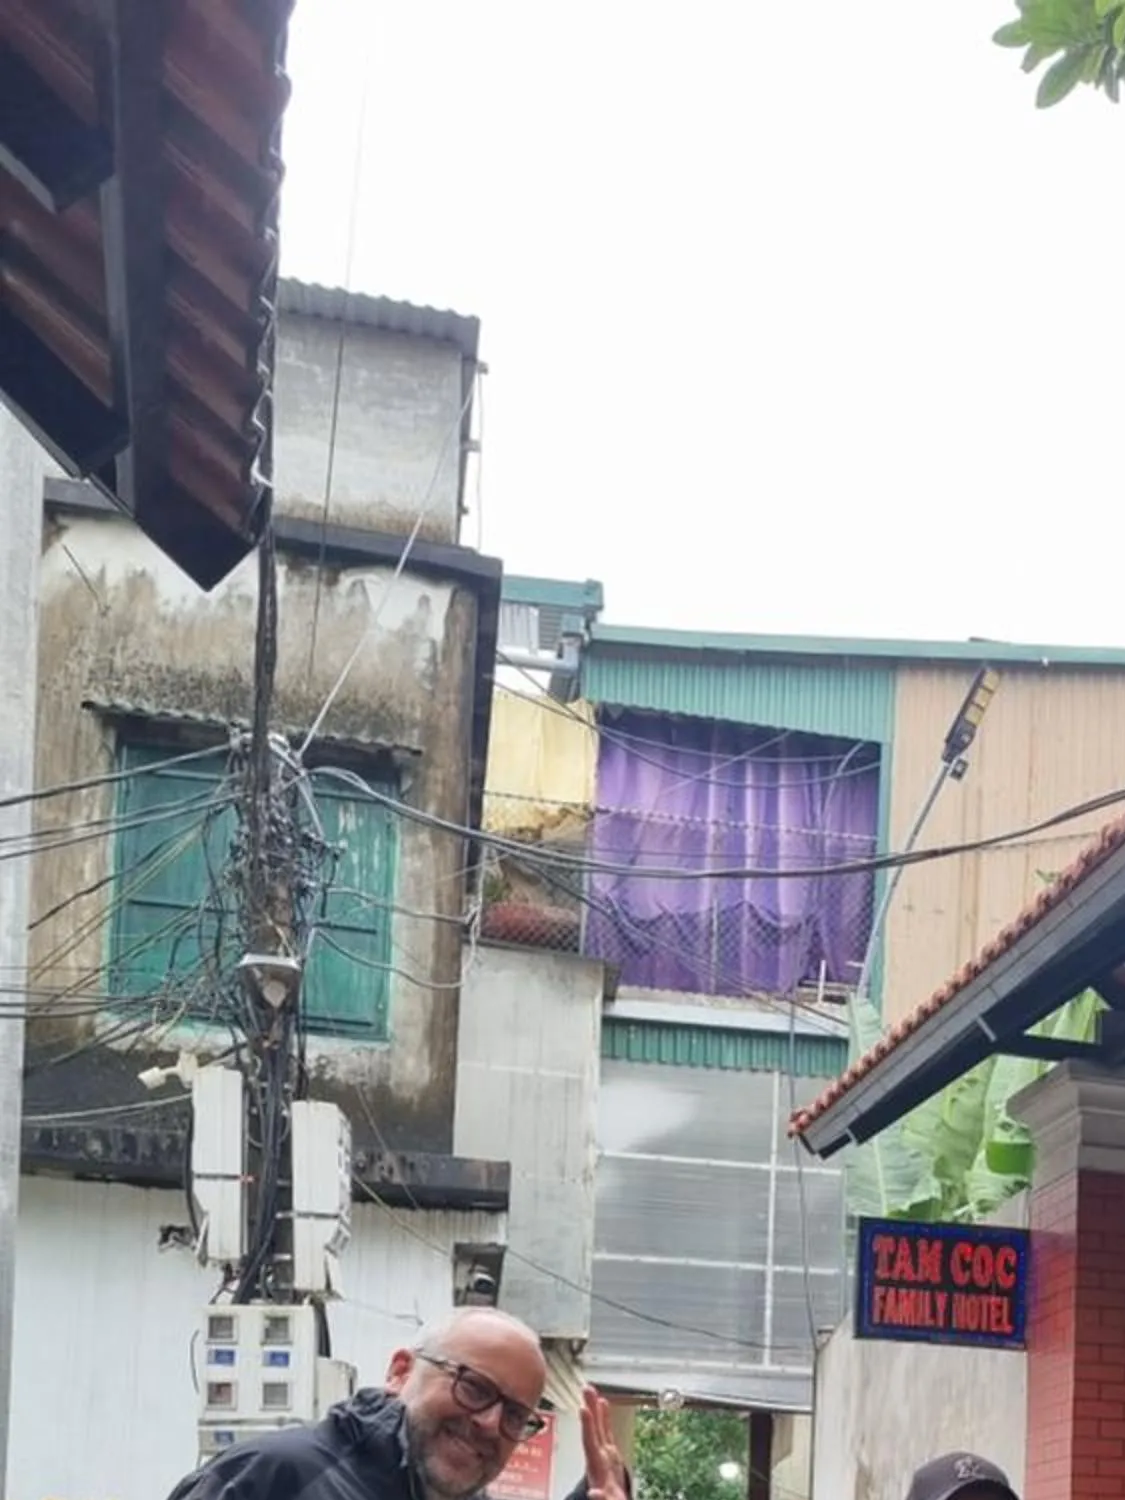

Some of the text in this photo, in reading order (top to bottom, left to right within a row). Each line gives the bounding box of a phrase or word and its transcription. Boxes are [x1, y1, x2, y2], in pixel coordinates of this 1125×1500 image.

[872, 1234, 1017, 1289] TAM COC
[873, 1284, 1014, 1334] FAMILY HOTEL
